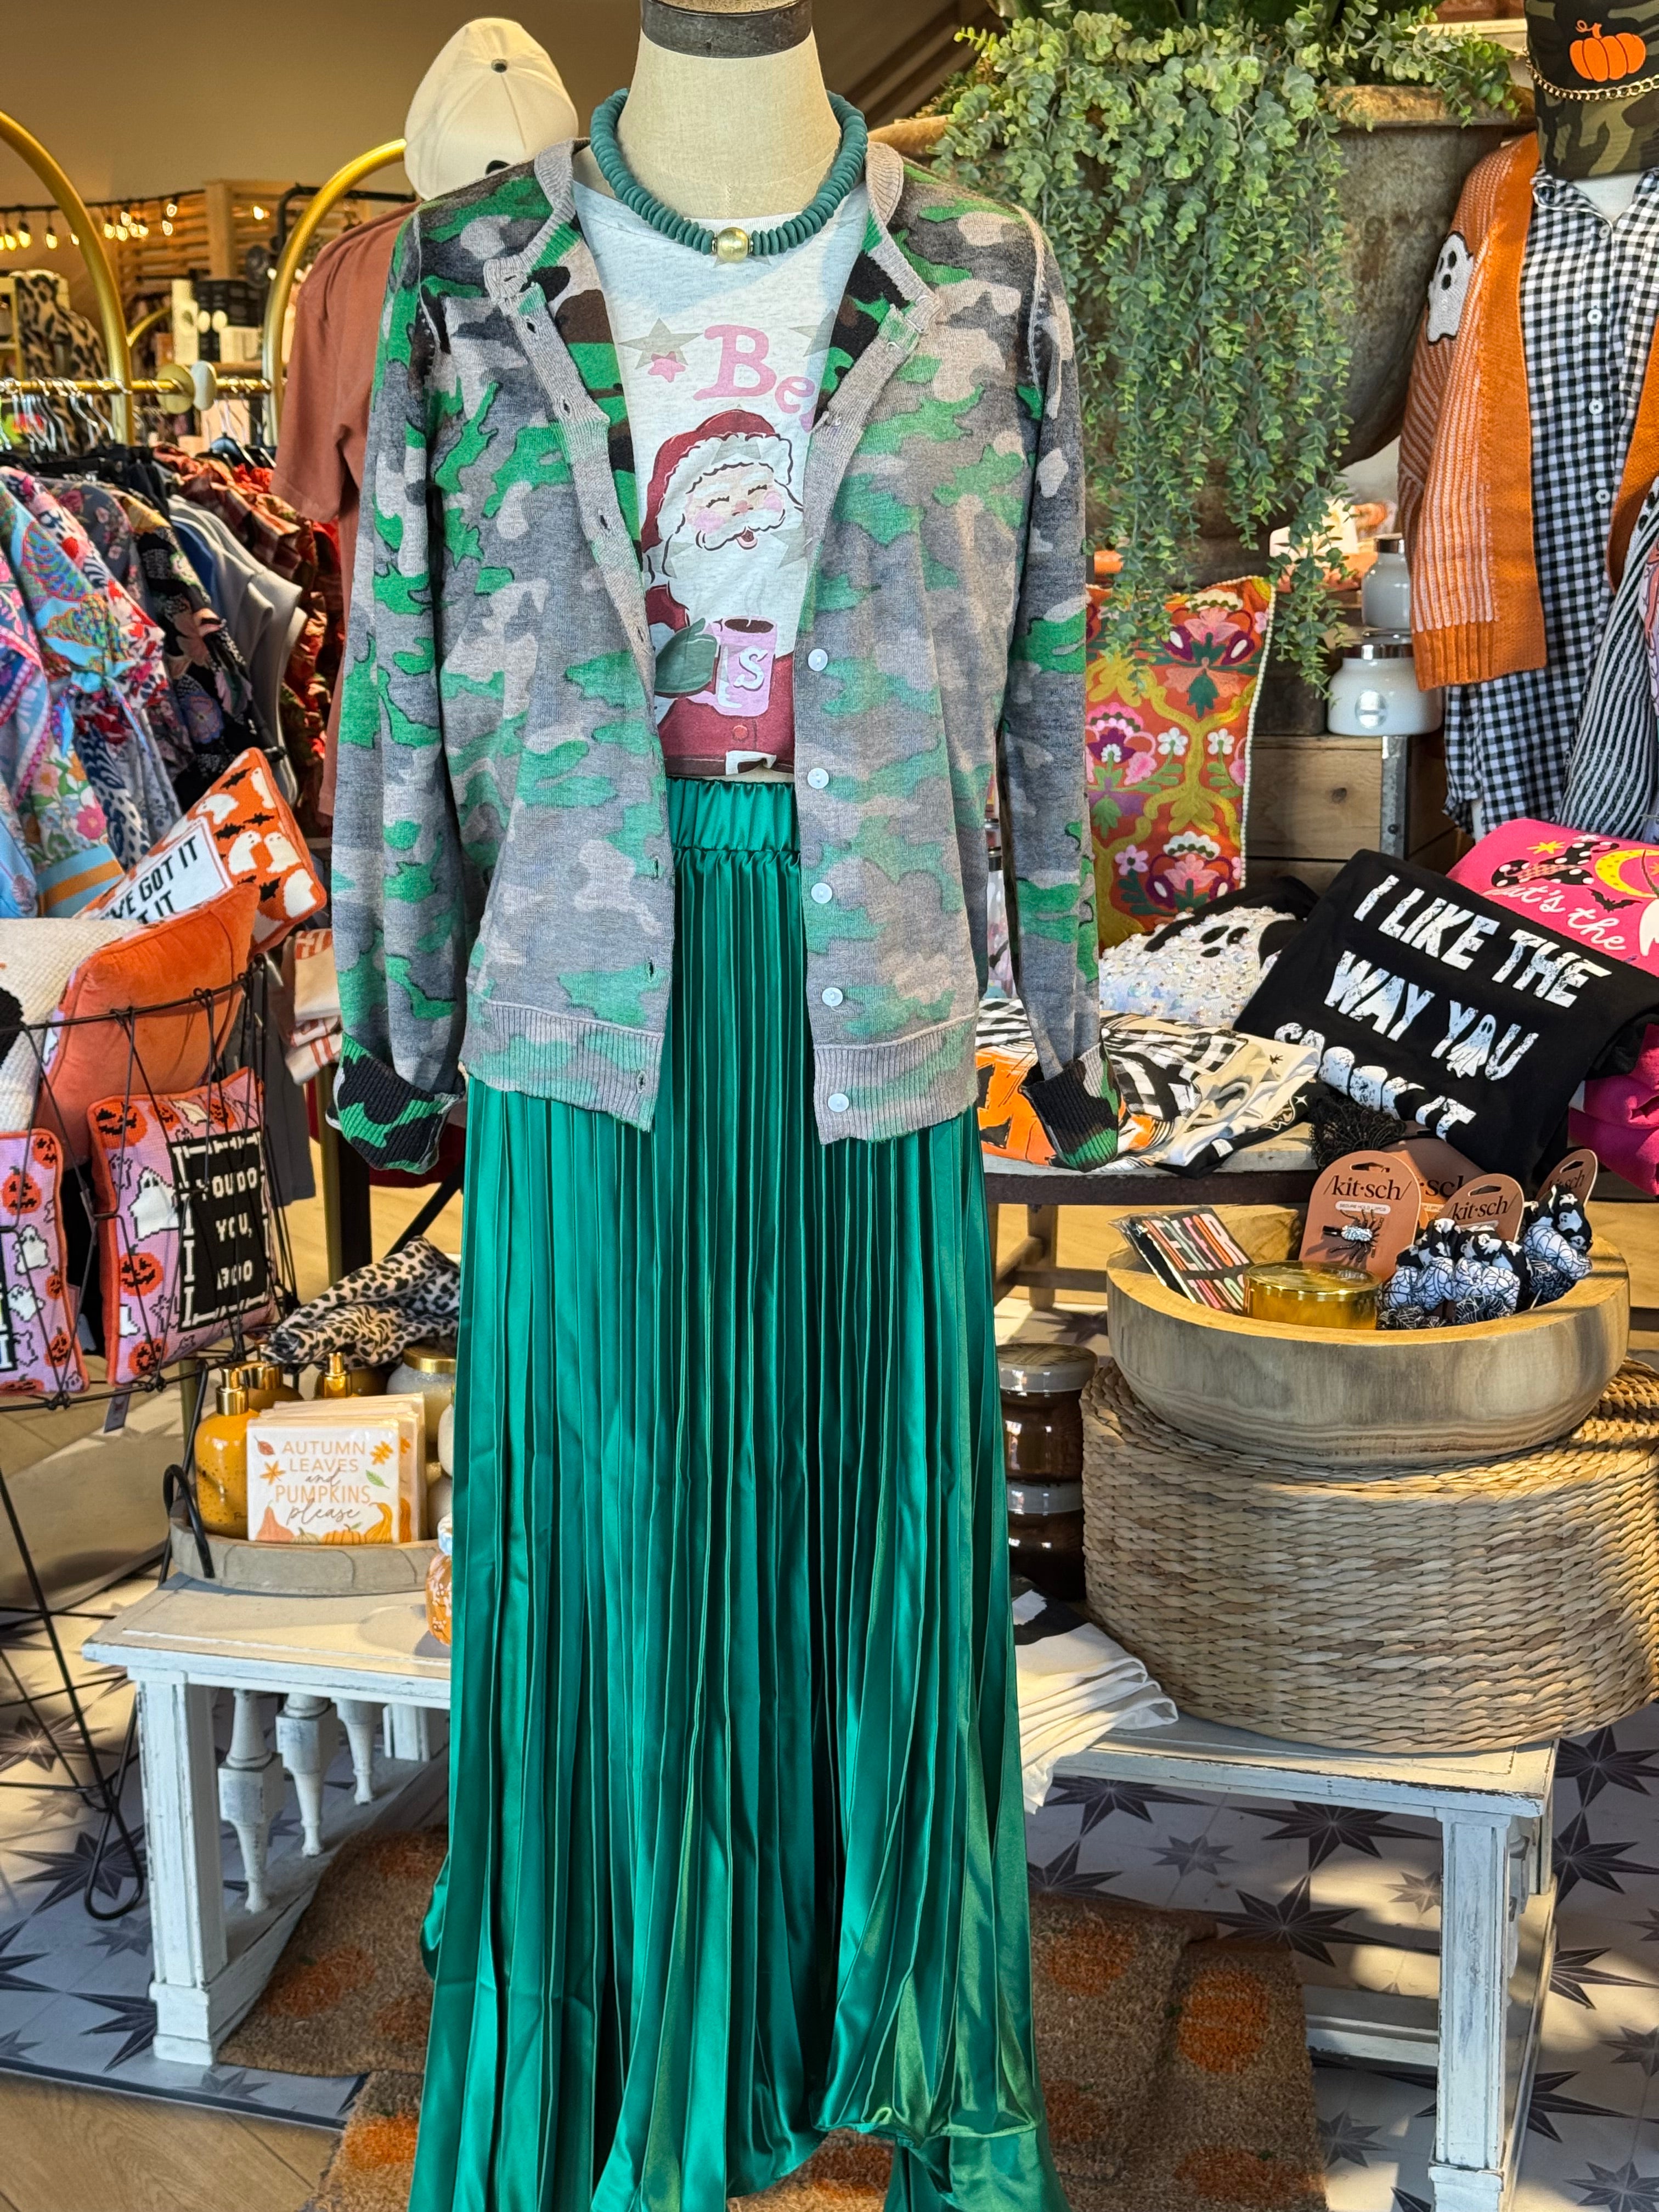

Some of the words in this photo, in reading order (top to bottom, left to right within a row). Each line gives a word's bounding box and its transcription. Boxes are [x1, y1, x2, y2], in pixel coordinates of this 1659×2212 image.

[693, 324, 817, 433] Be
[138, 855, 174, 902] GOT
[177, 835, 198, 869] IT
[154, 890, 176, 918] IT
[1353, 874, 1400, 922] I
[1378, 887, 1500, 970] LIKE
[1491, 929, 1612, 1008] THE
[1567, 907, 1626, 950] the
[1324, 950, 1435, 1042] WAY
[1181, 1212, 1250, 1270] FOR
[281, 1440, 366, 1455] AUTUMN
[289, 1458, 359, 1472] LEAVES
[275, 1485, 371, 1504] PUMPKINS
[305, 1467, 341, 1487] and
[286, 1498, 360, 1526] please
